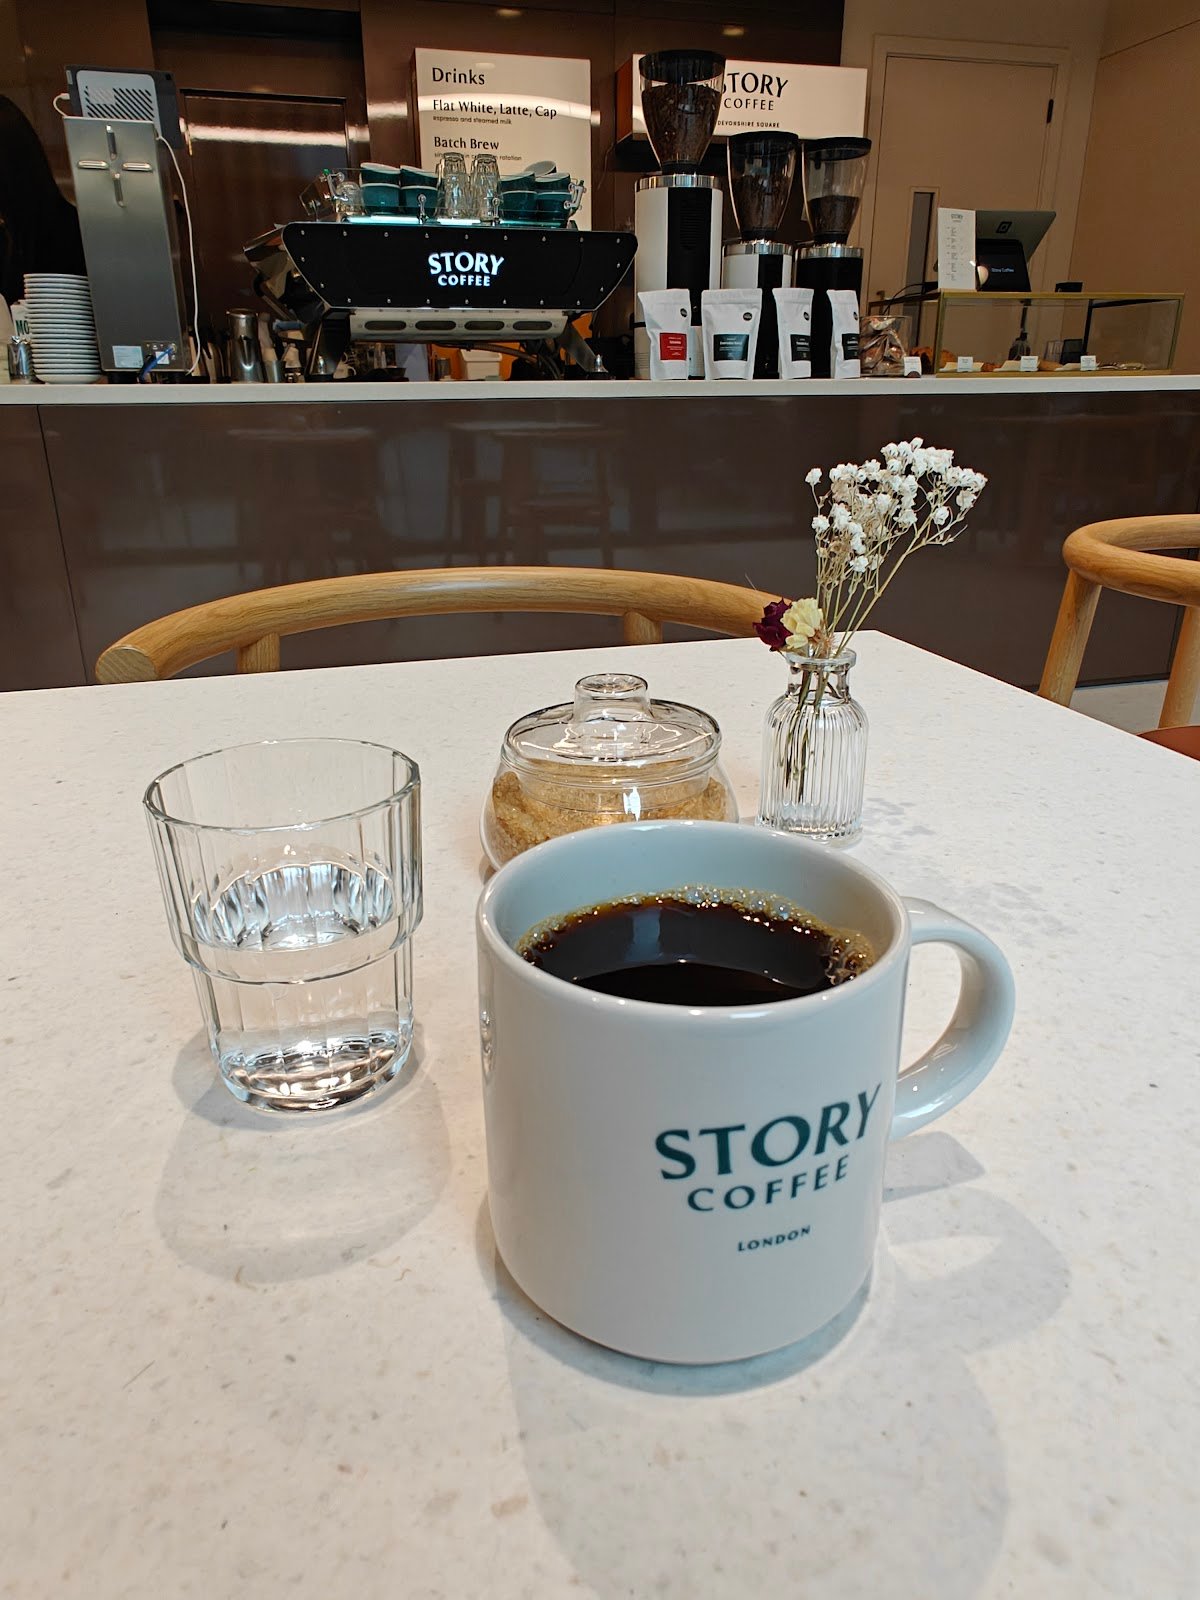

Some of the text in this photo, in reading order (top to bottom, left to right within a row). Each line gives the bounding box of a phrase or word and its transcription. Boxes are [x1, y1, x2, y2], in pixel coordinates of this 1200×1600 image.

[432, 67, 485, 85] Drinks
[723, 72, 789, 98] TORY
[433, 99, 557, 120] Flat White, Latte, Cap
[724, 98, 774, 111] COFFEE
[433, 115, 459, 123] espresso
[434, 136, 500, 150] Batch Brew
[428, 251, 505, 275] STORY
[437, 274, 491, 287] COFFEE
[655, 1082, 882, 1180] STORY
[687, 1153, 849, 1212] COFFEE
[737, 1225, 811, 1252] LONDON
